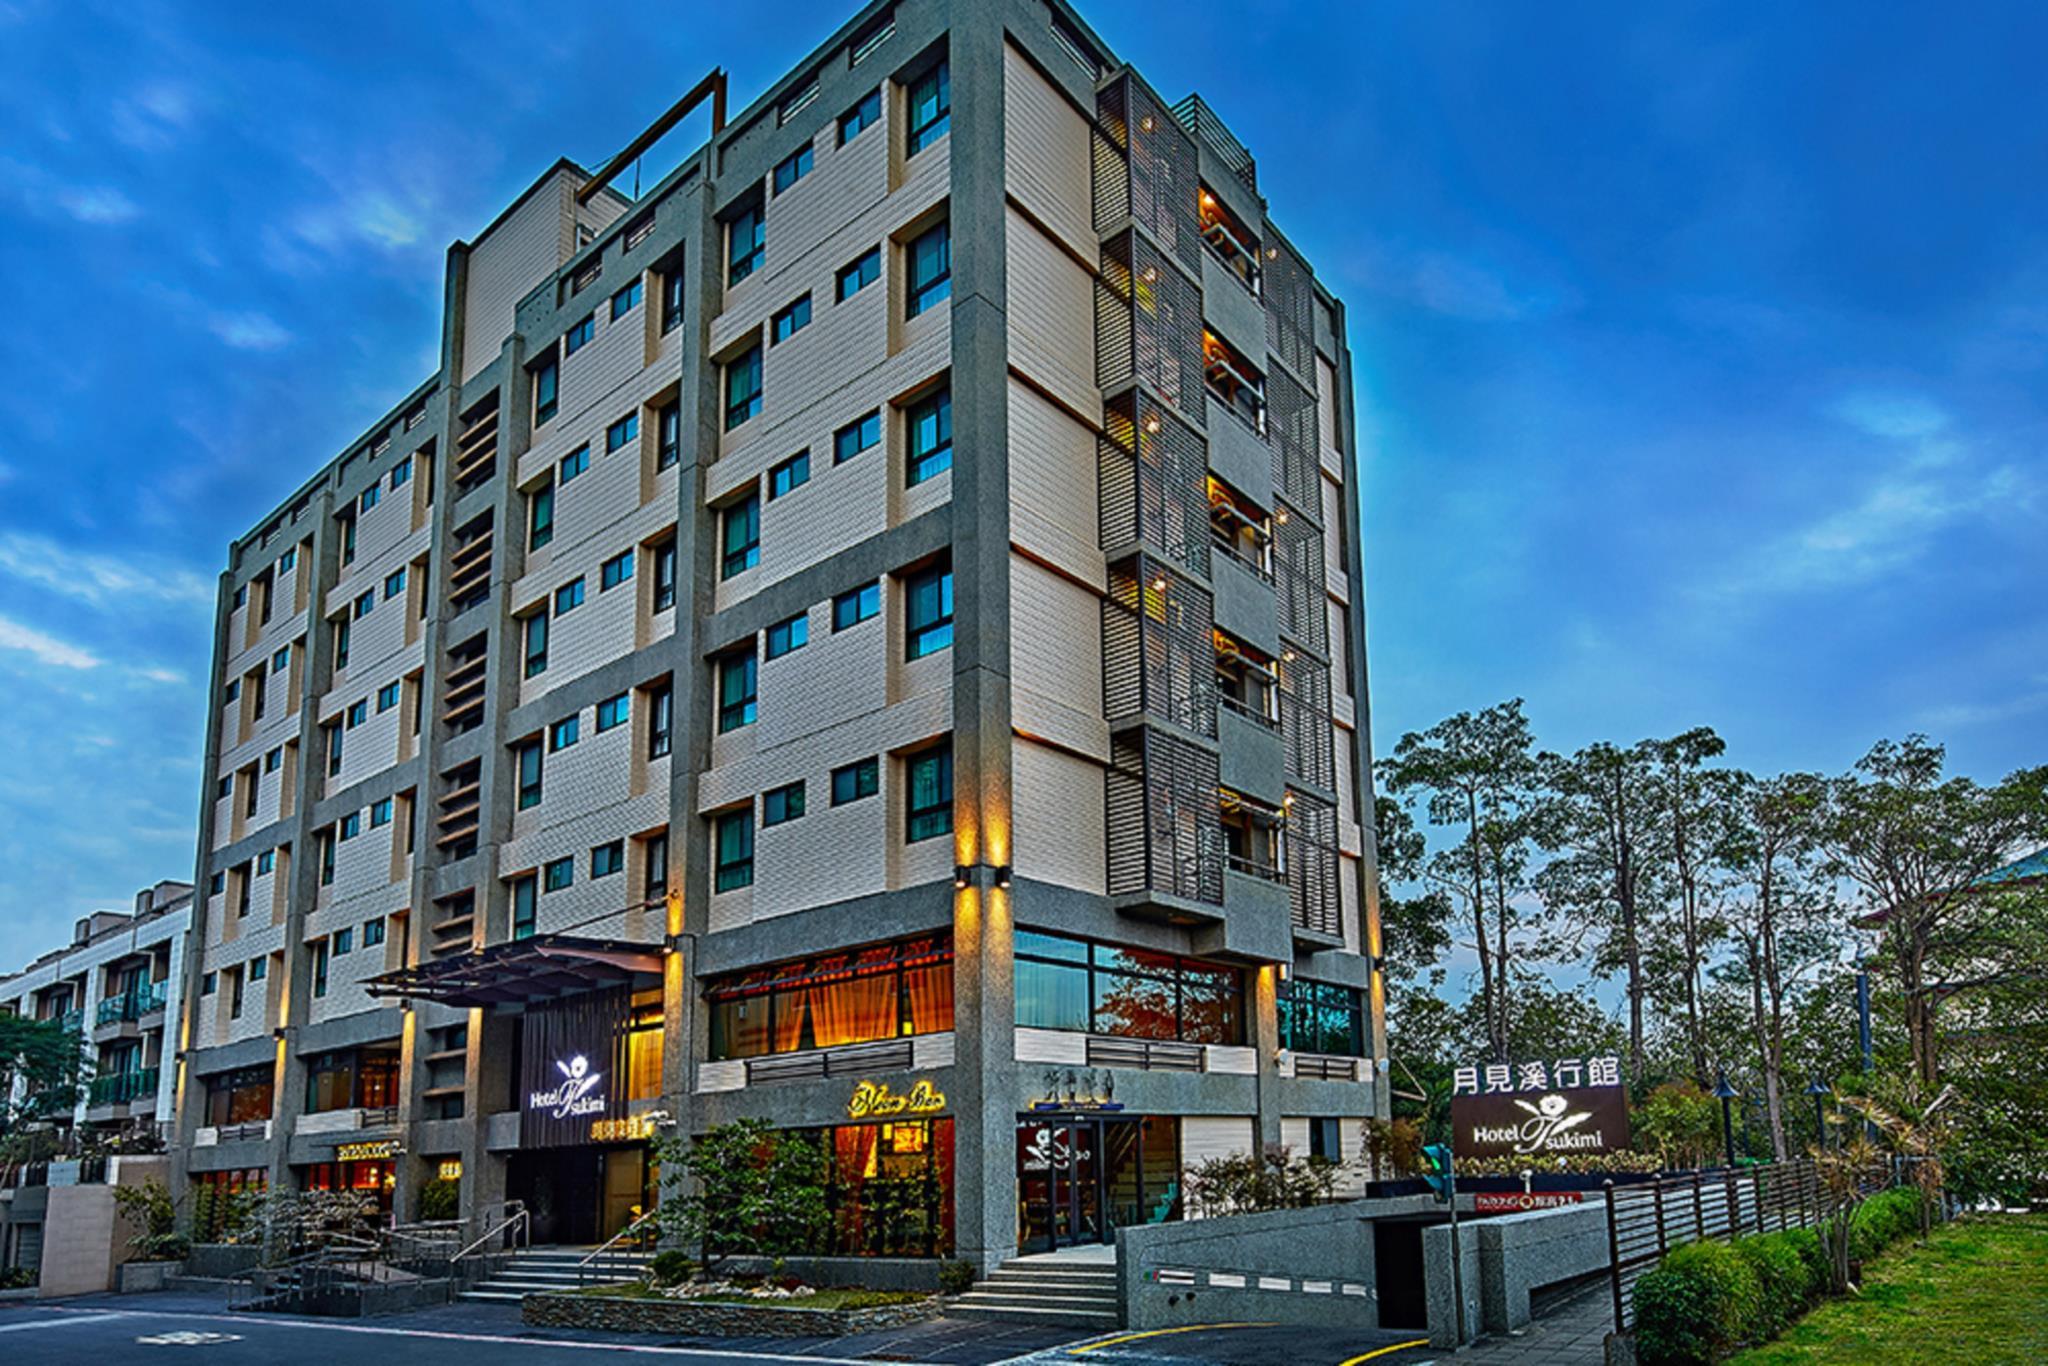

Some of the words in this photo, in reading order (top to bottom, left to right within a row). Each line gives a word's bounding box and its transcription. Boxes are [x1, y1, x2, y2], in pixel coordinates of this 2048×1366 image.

[1453, 1056, 1620, 1096] 月見溪行館
[530, 1089, 558, 1110] Hotel
[1473, 1124, 1519, 1143] Hotel
[1513, 1114, 1603, 1153] Tsukimi
